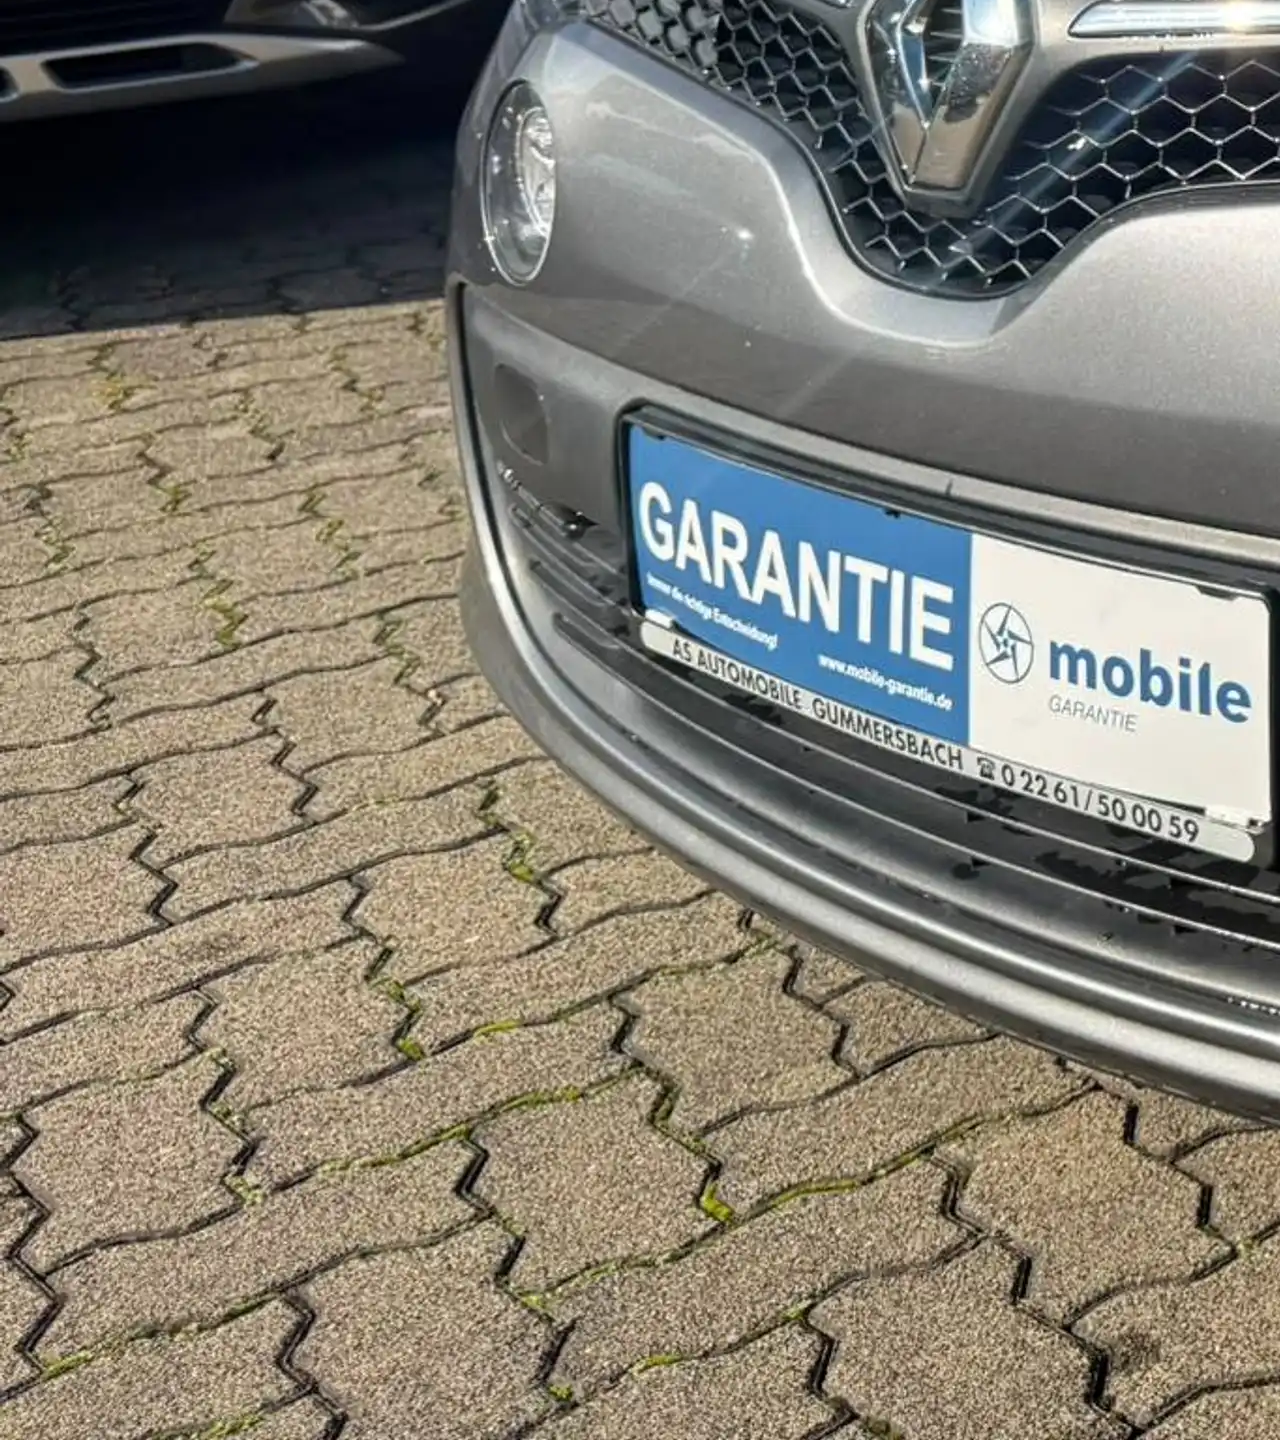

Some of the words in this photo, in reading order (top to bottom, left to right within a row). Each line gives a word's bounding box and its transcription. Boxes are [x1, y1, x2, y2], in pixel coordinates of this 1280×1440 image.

[638, 481, 955, 672] GARANTIE
[672, 638, 693, 663] AS
[697, 648, 804, 711] AUTOMOBILE
[811, 696, 964, 771] GUMMERSBACH
[817, 654, 954, 712] www.mobile-garantie.de
[1048, 693, 1140, 734] GARANTIE
[1049, 639, 1253, 724] mobile
